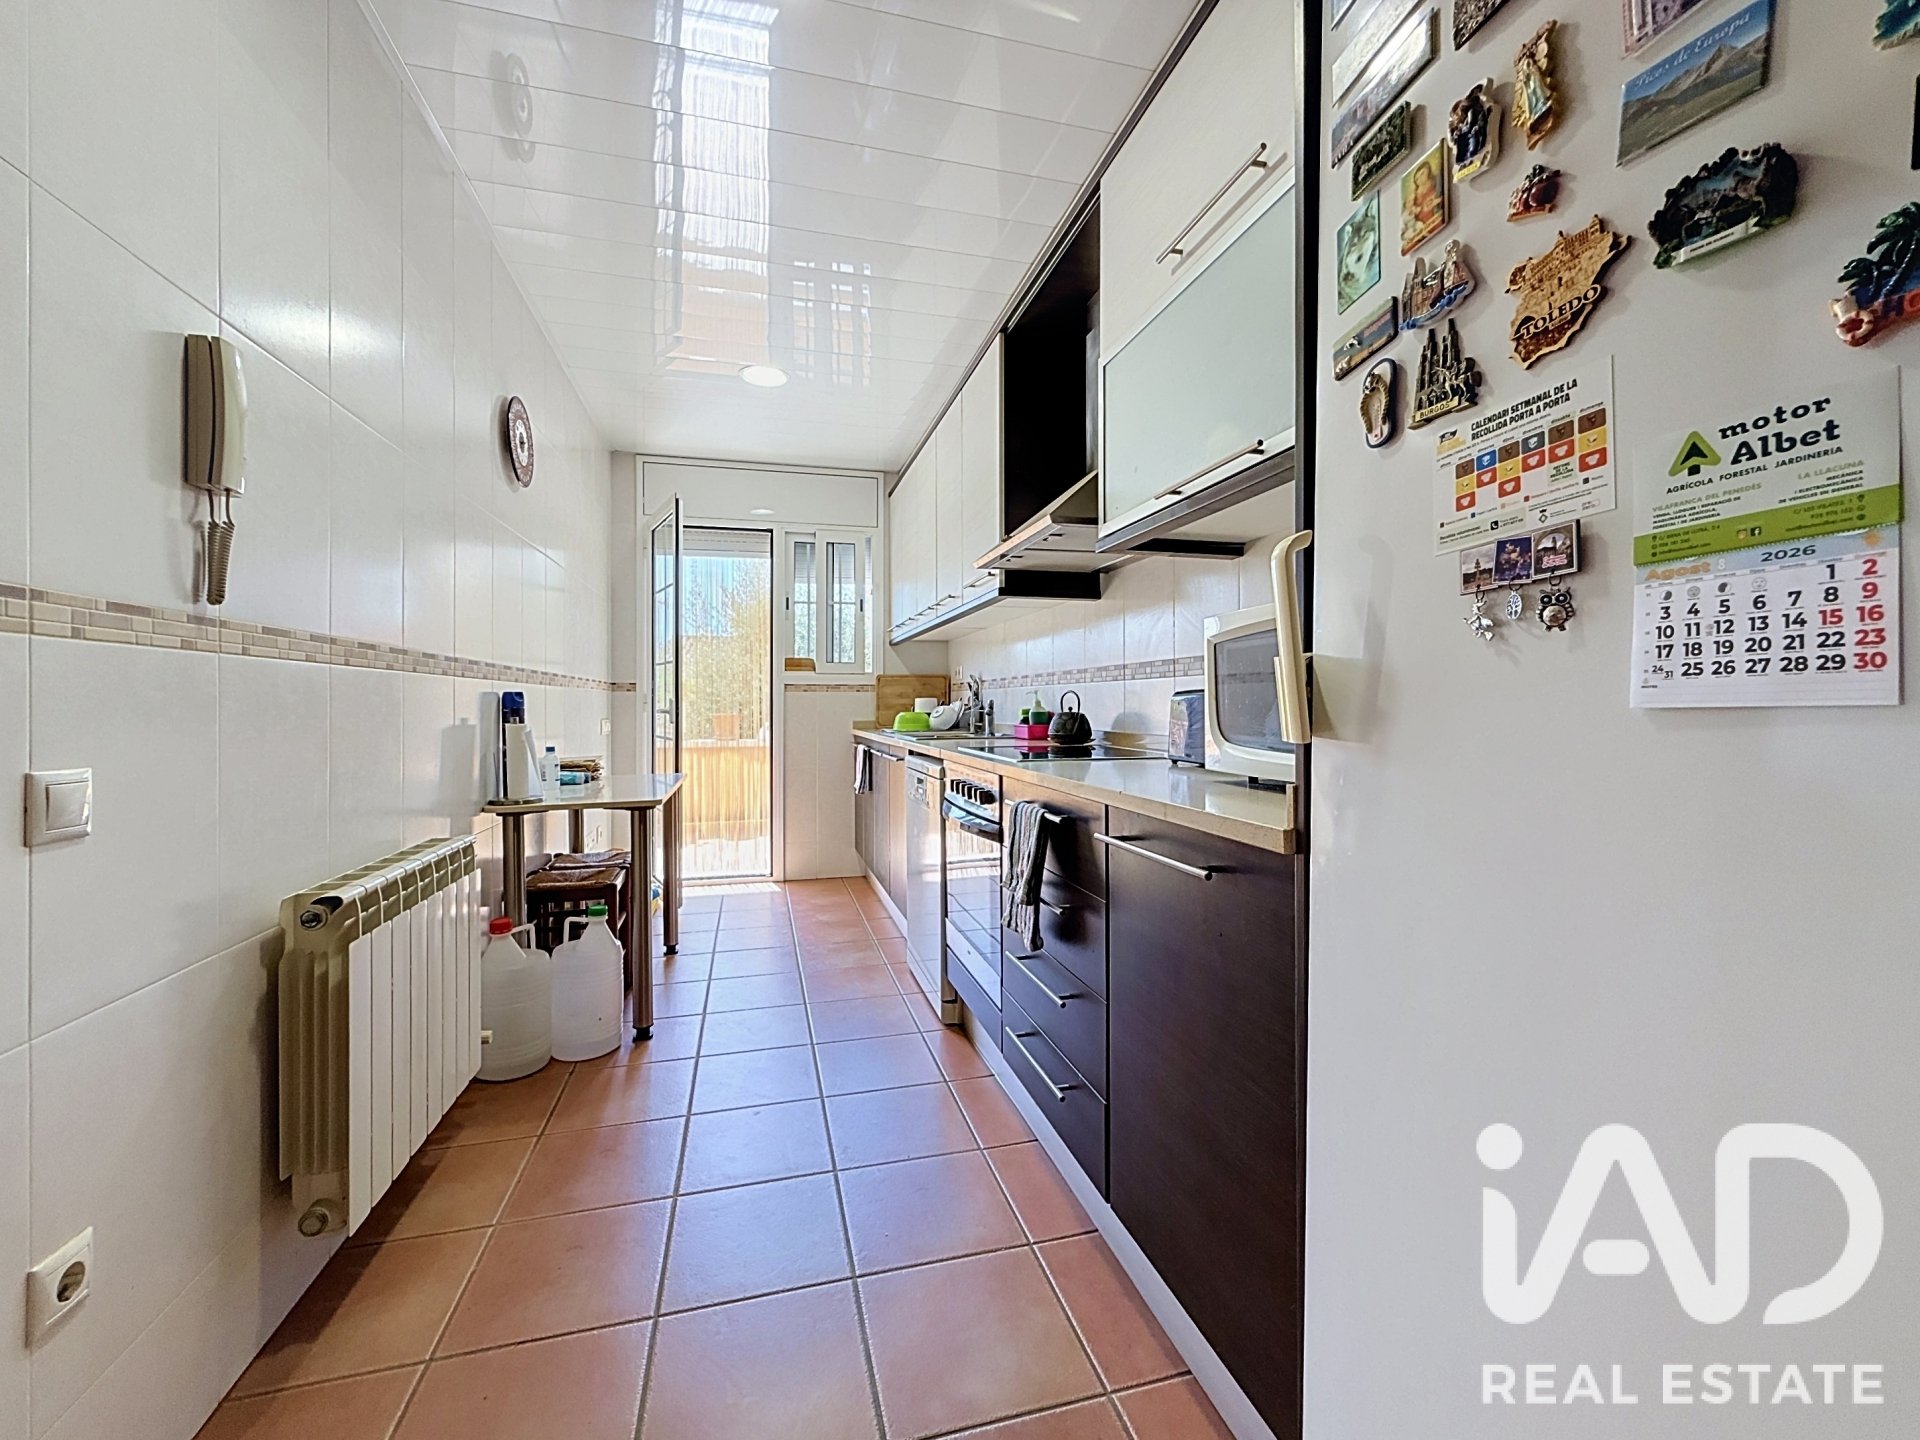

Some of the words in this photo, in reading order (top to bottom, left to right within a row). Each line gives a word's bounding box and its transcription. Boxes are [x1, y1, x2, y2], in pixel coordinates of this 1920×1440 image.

[1694, 12, 1750, 53] Europa
[1521, 284, 1601, 337] TOLEDO
[1419, 401, 1451, 419] BURGOS
[1471, 408, 1510, 431] CALENDARI
[1510, 392, 1552, 415] SETMANAL
[1553, 383, 1565, 396] DE
[1566, 378, 1578, 391] LA
[1471, 420, 1508, 442] RECOLLIDA
[1509, 409, 1534, 426] PORTA
[1535, 405, 1542, 415] A
[1543, 393, 1571, 412] PORTA
[1718, 397, 1831, 440] motor
[1730, 419, 1841, 466] Albet
[1666, 477, 1714, 495] AGRÍCOLA
[1719, 464, 1768, 482] FORESTAL
[1774, 446, 1844, 469] JARDINERIA
[1797, 471, 1811, 480] LA
[1814, 459, 1864, 476] LLACUNA
[1652, 496, 1703, 513] VILAFRANCA
[1705, 493, 1720, 501] DEL
[1644, 561, 1712, 582] Agost
[1717, 559, 1726, 571] 8
[1760, 544, 1816, 563] 2026
[1826, 563, 1836, 580] 1
[1861, 558, 1879, 576] 2
[1660, 605, 1671, 620] 3
[1686, 602, 1700, 617] 4
[1718, 598, 1731, 614] 5
[1752, 594, 1767, 610] 6
[1787, 590, 1803, 607] 7
[1823, 586, 1839, 603] 8
[1861, 581, 1879, 599] 9
[1655, 624, 1675, 640] 10
[1684, 621, 1701, 637] 11
[1713, 618, 1735, 635] 12
[1747, 615, 1769, 632] 13
[1781, 611, 1807, 629] 14
[1818, 608, 1844, 626] 15
[1855, 604, 1885, 623] 16
[1655, 643, 1674, 659] 17
[1682, 641, 1703, 657] 18
[1713, 639, 1734, 655] 19
[1744, 636, 1772, 653] 20
[1782, 633, 1805, 651] 21
[1816, 631, 1846, 648] 22
[1854, 628, 1887, 646] 23
[1651, 664, 1664, 673] 24
[1664, 670, 1674, 679] 31
[1681, 661, 1704, 677] 25
[1711, 659, 1736, 676] 26
[1745, 657, 1772, 674] 27
[1779, 655, 1809, 673] 28
[1815, 653, 1847, 671] 29
[1853, 651, 1888, 670] 30
